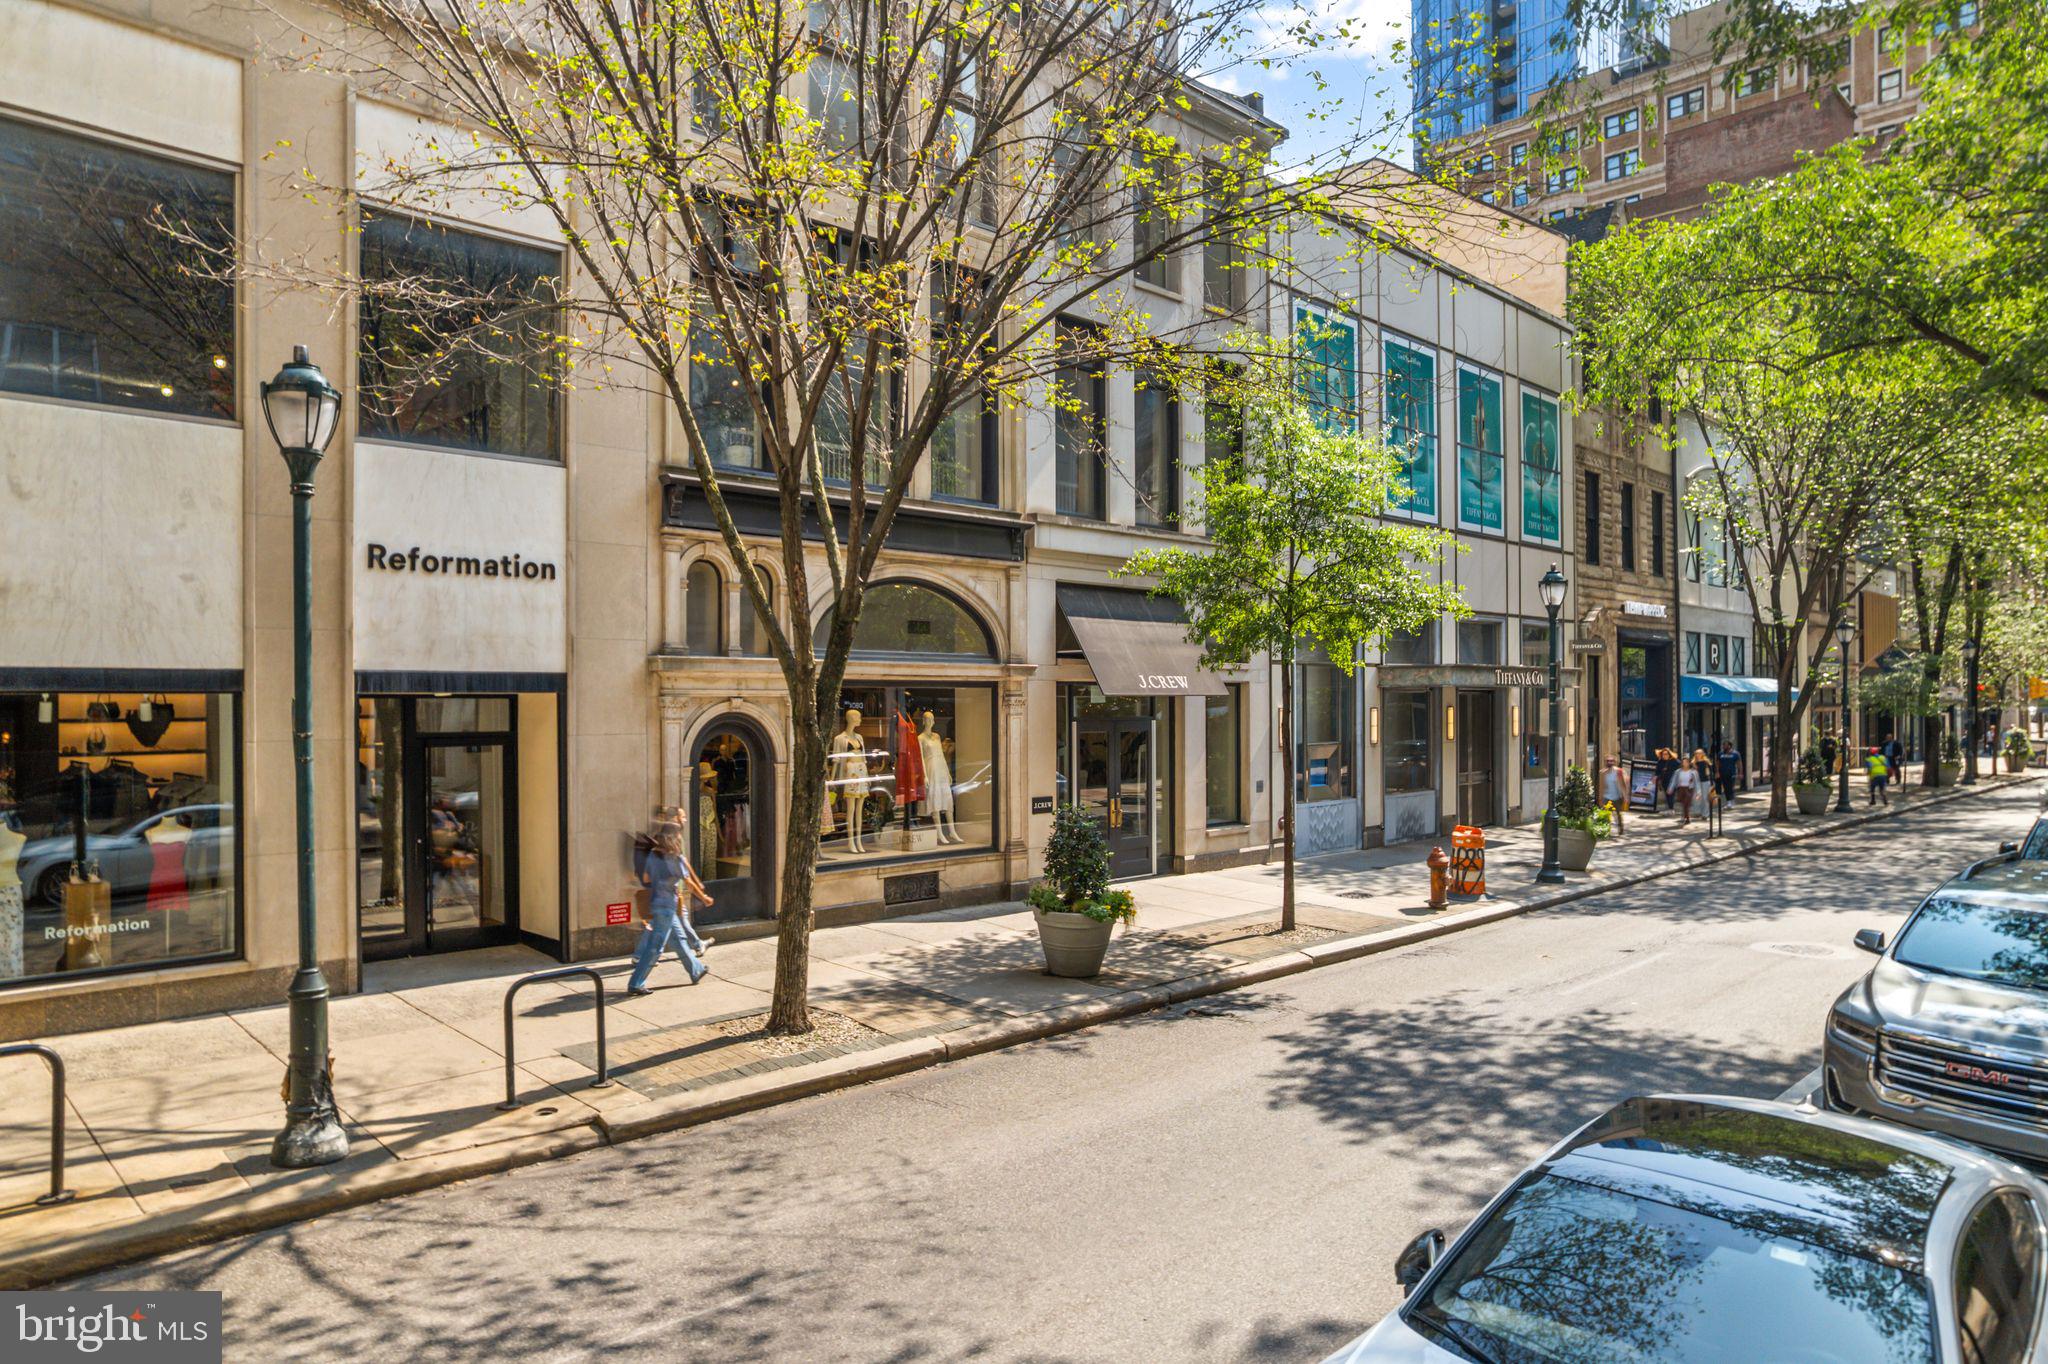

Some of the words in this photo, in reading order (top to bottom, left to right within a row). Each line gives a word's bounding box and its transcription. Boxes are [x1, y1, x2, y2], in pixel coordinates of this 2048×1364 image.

[367, 543, 556, 580] Reformation
[1138, 674, 1189, 689] J.CREW
[44, 919, 150, 940] Reformation
[1946, 1061, 2029, 1091] GMC
